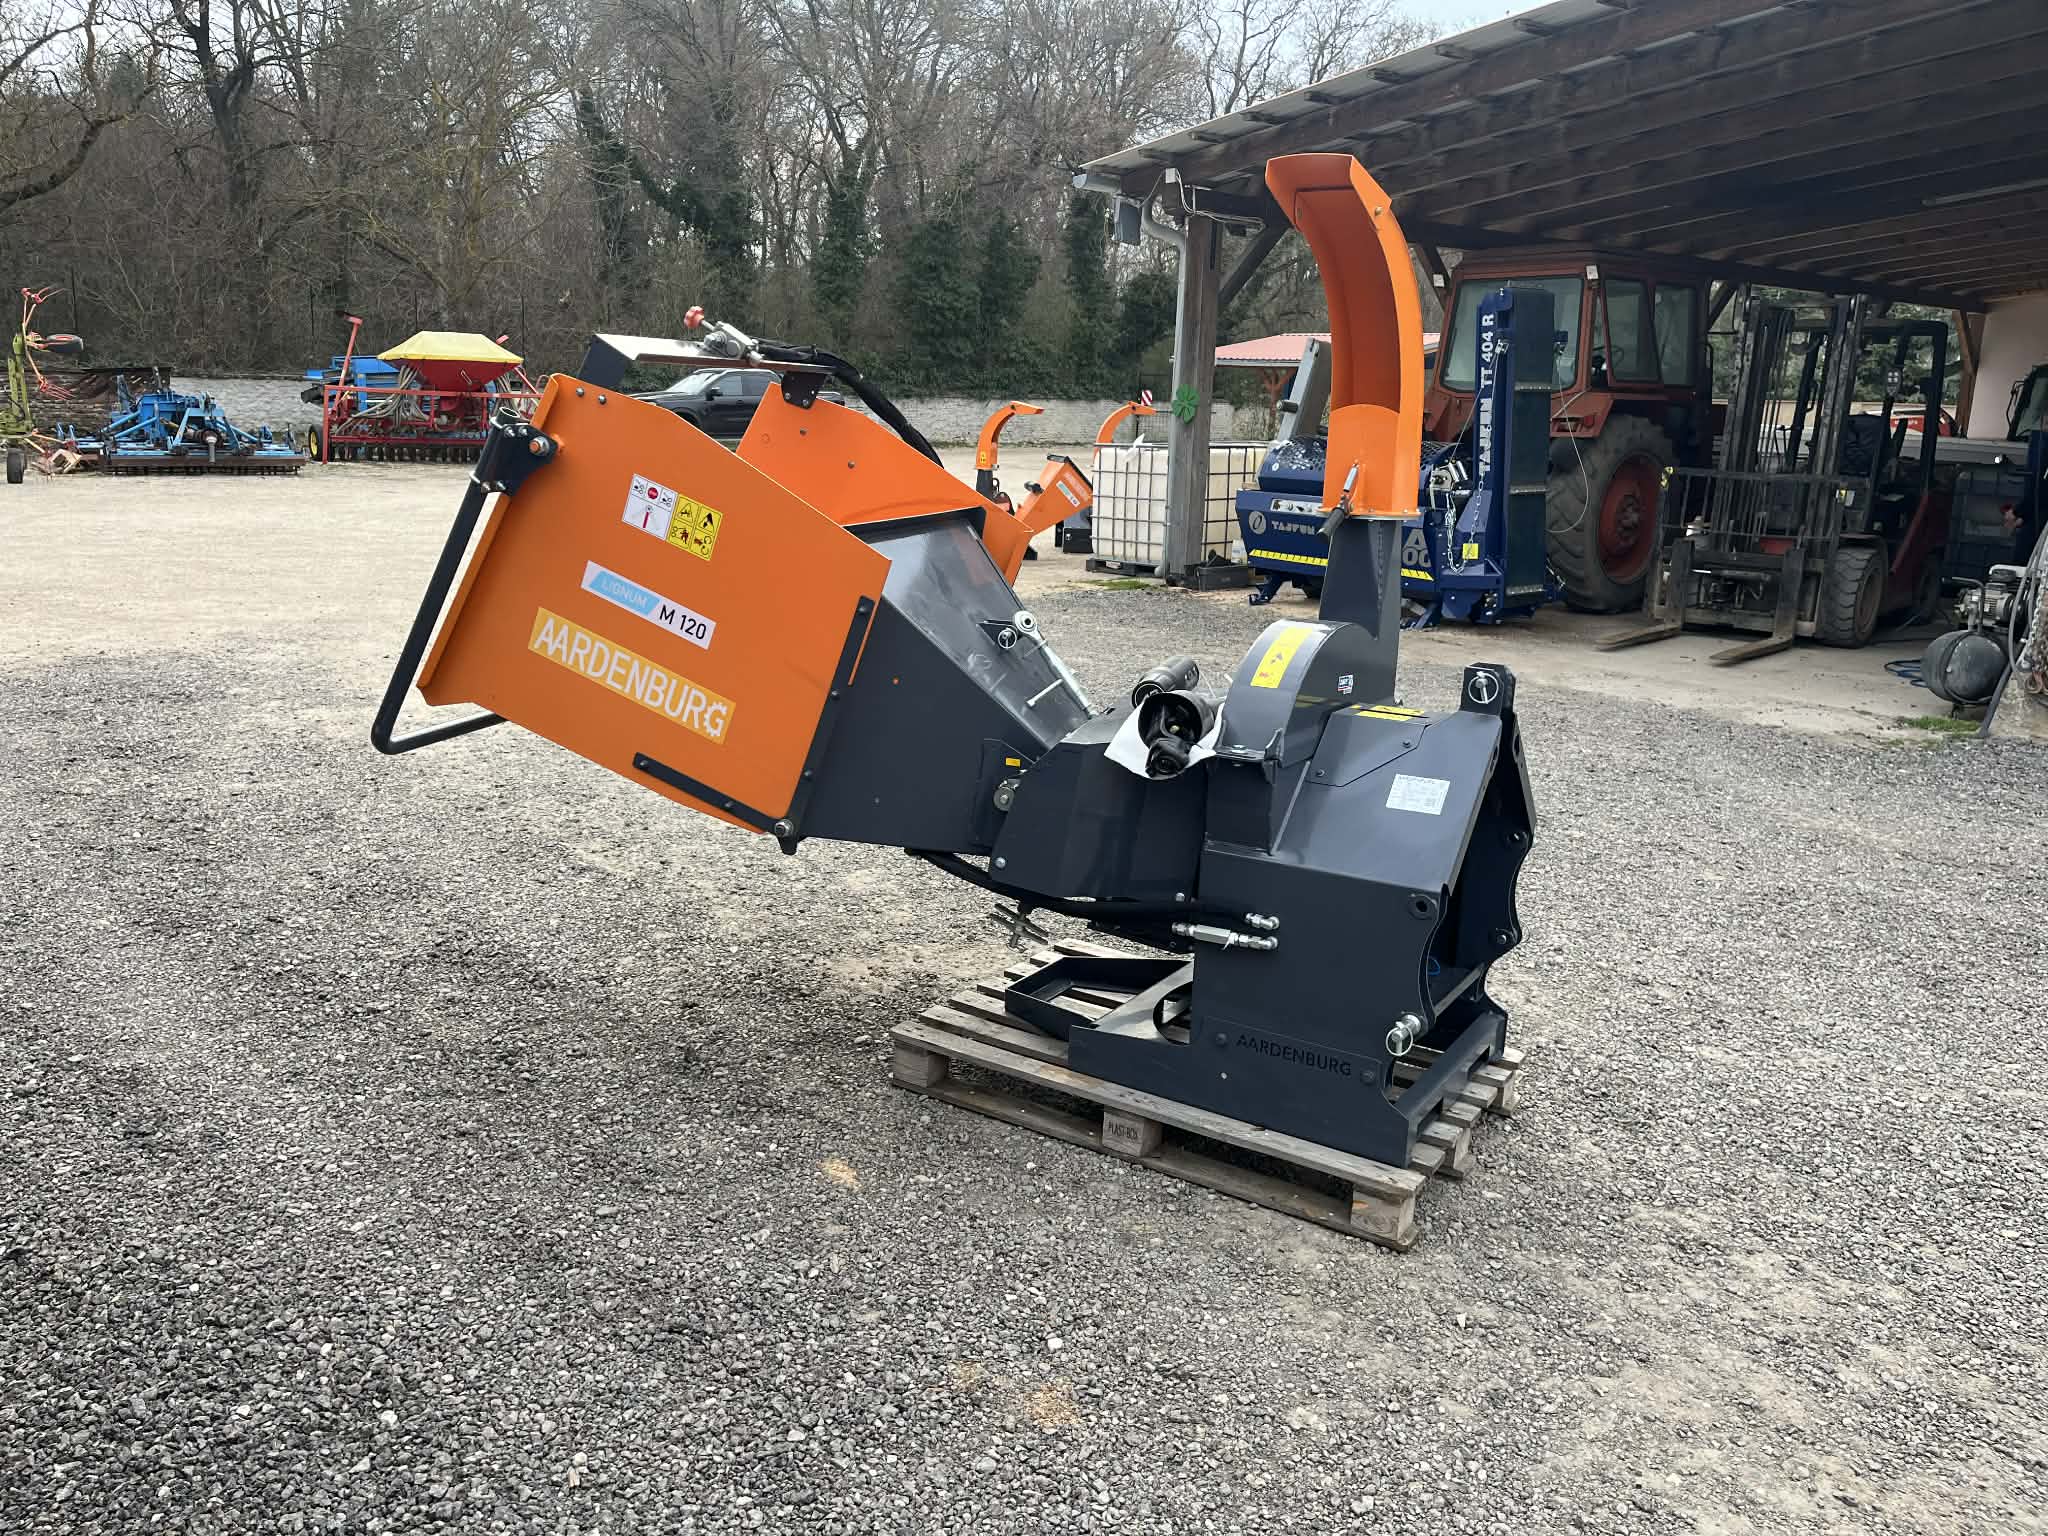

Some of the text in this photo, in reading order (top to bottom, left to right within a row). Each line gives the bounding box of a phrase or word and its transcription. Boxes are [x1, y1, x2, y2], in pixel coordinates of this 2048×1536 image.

[1482, 314, 1495, 327] R
[1481, 331, 1494, 362] 404
[1481, 367, 1493, 388] TT
[601, 576, 707, 640] LIGNUM M 120
[534, 617, 728, 737] AARDENBURG
[1236, 1033, 1352, 1077] AARDENBURG
